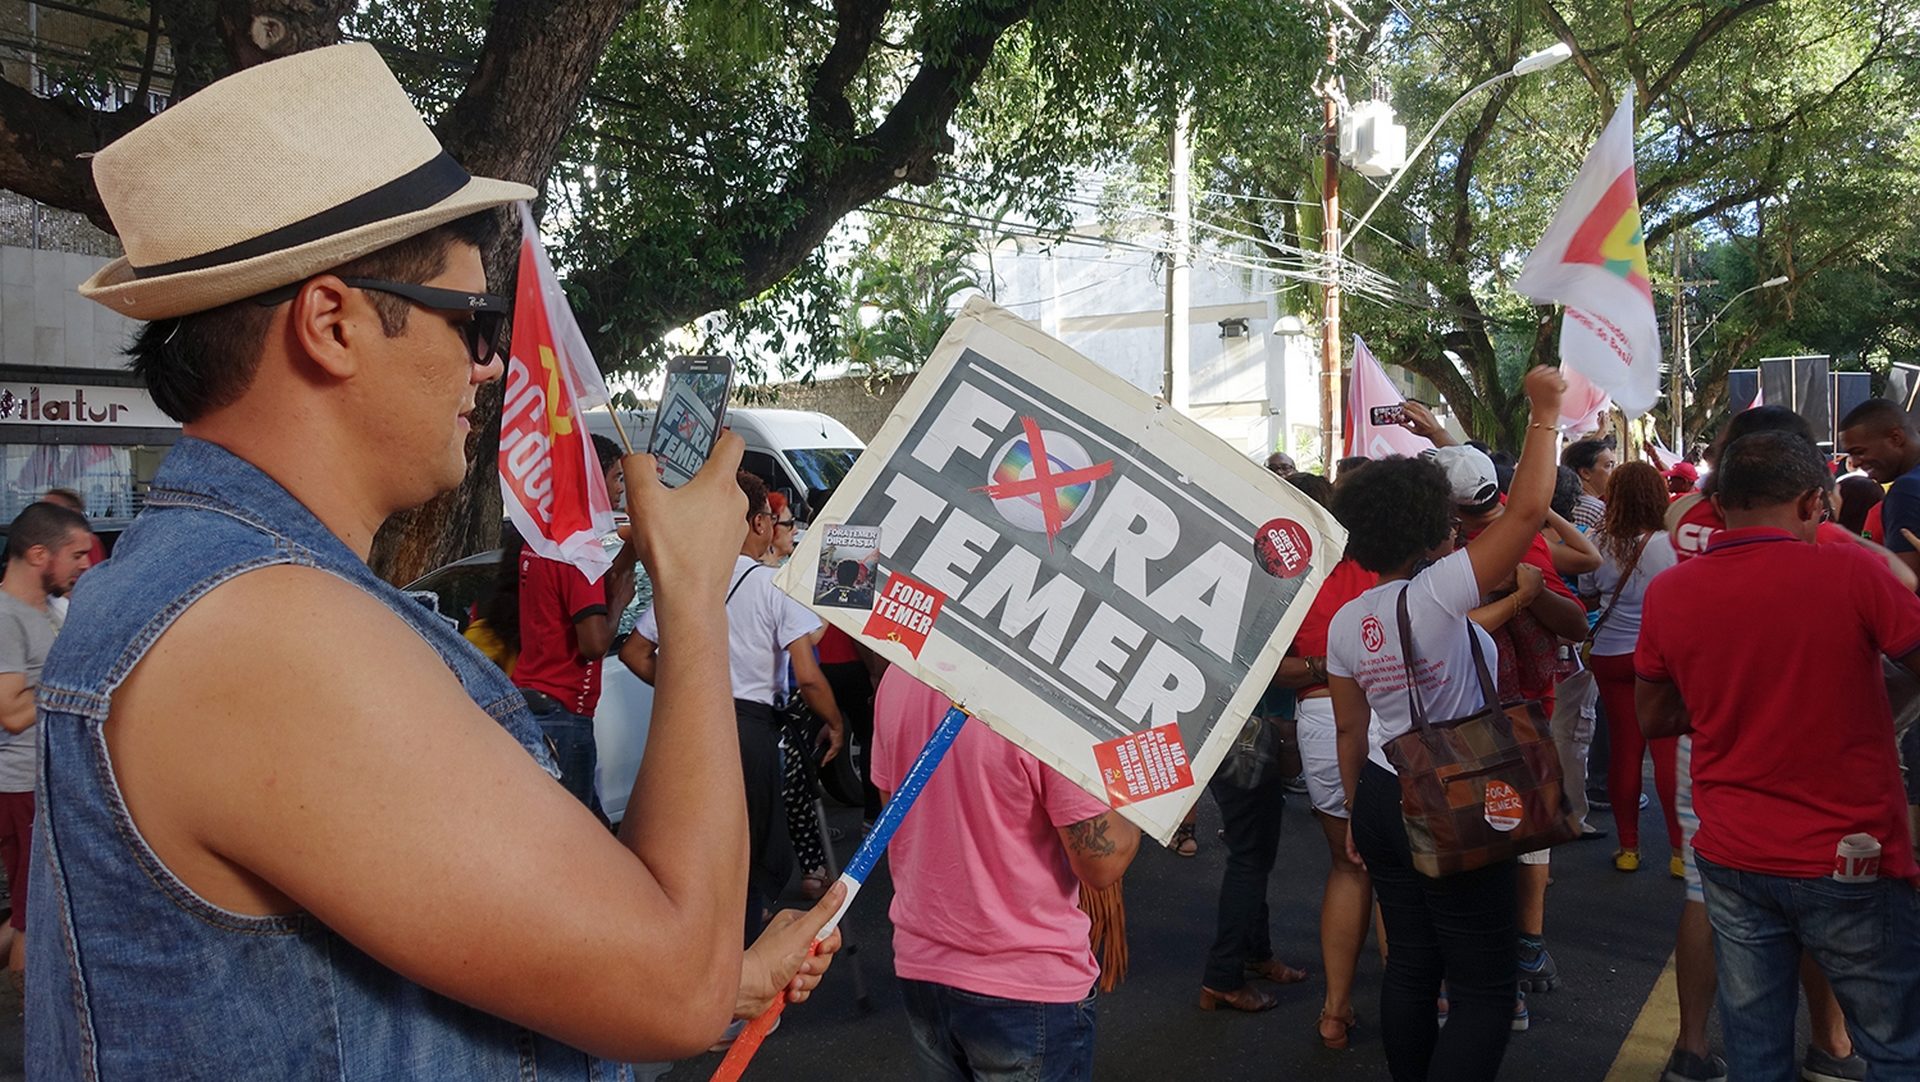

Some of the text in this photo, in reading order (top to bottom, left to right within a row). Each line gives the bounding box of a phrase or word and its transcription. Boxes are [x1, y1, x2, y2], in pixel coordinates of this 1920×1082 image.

[1267, 528, 1298, 572] GERAL!
[1278, 528, 1302, 563] GREVE
[875, 596, 934, 637] TEMER
[877, 472, 1206, 730] TEMER
[889, 580, 936, 616] FORA
[1116, 744, 1135, 782] DIRETAS
[1126, 738, 1150, 796] FORA TEMER!
[1160, 742, 1179, 785] REFORMAS
[1170, 741, 1186, 767] NÃO
